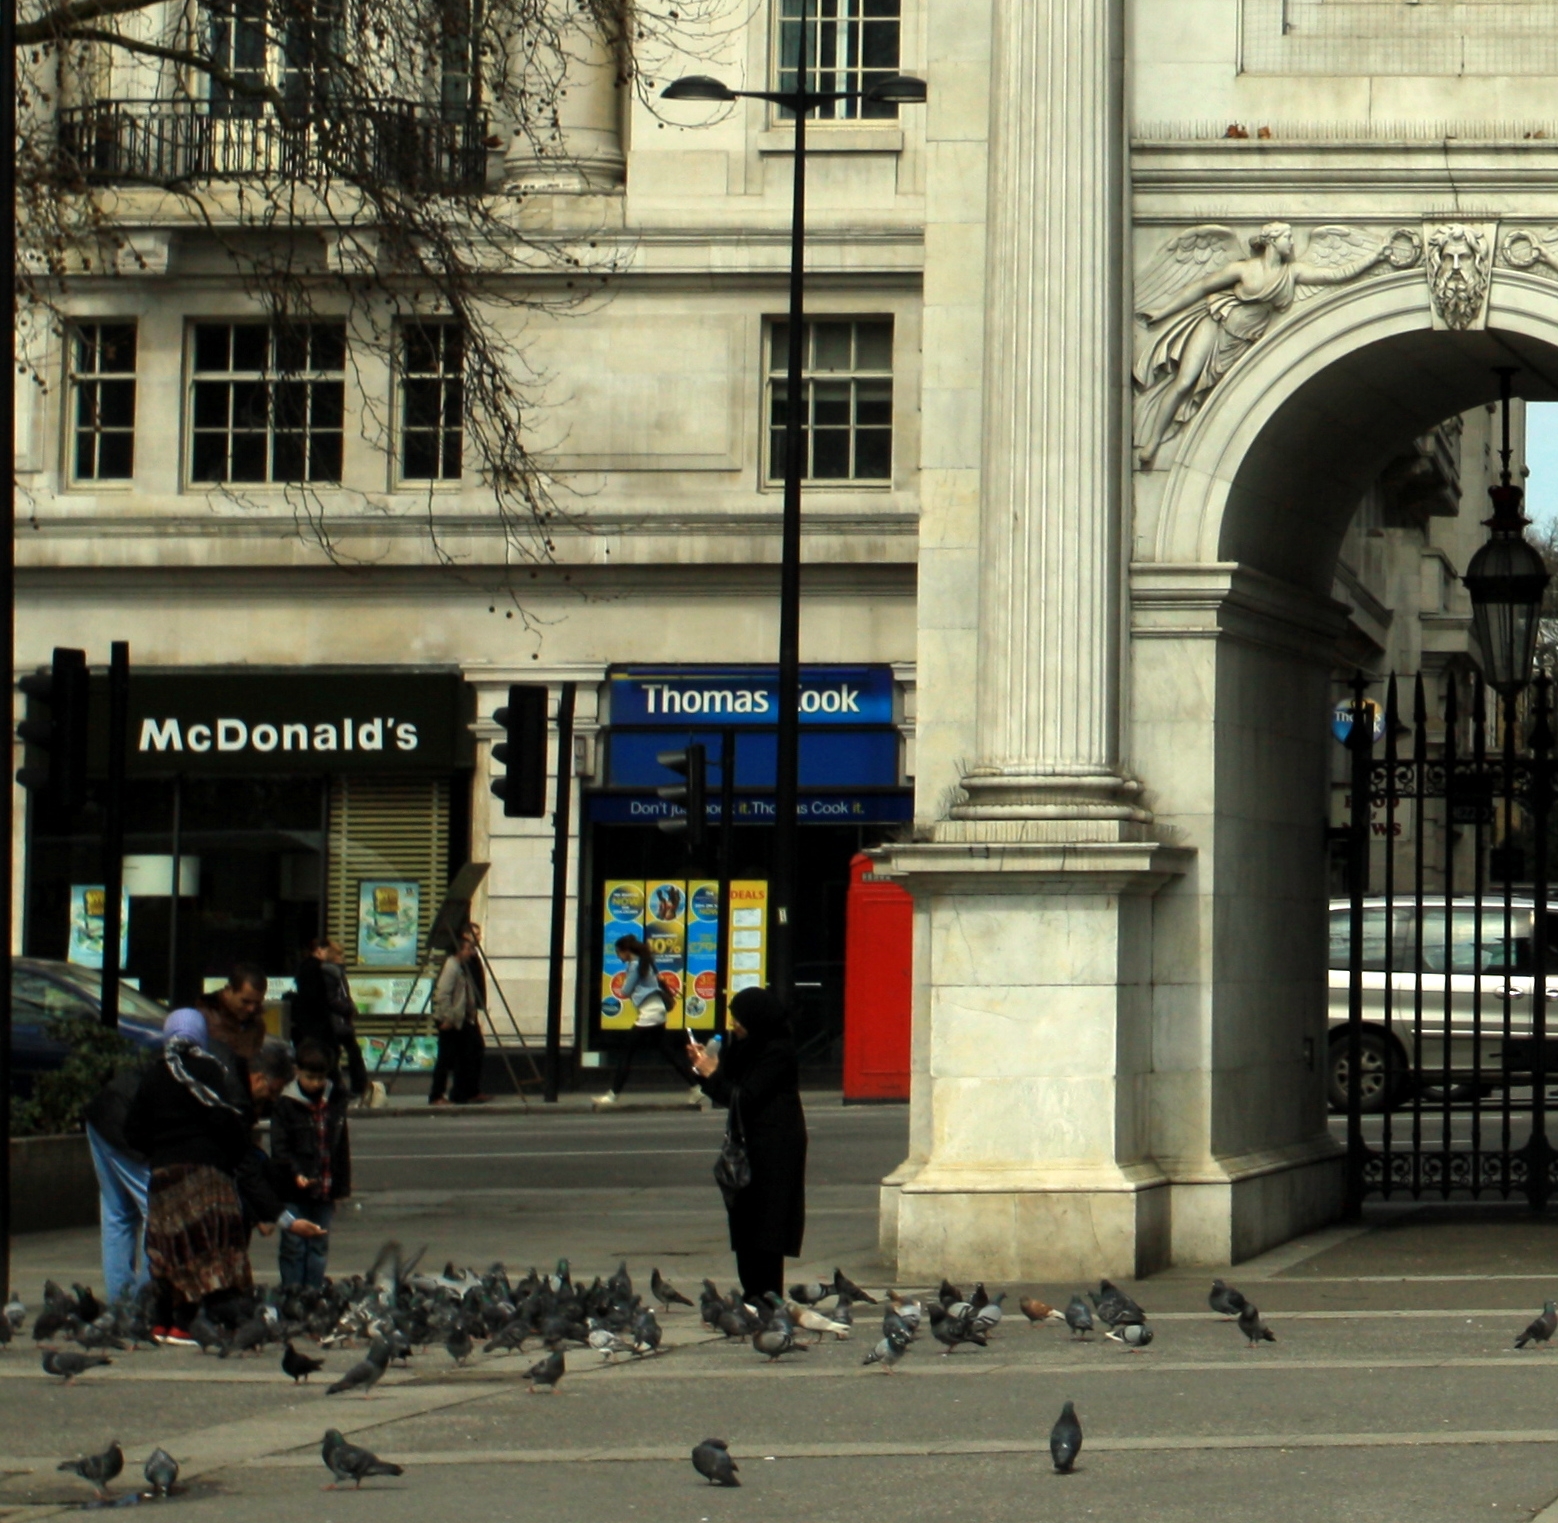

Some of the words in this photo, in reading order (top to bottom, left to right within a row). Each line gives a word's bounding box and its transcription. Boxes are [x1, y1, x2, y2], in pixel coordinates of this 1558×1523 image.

[641, 684, 770, 714] Thomas
[797, 684, 860, 713] ook
[1334, 710, 1381, 723] Thos
[138, 717, 419, 752] McDonald's
[630, 801, 668, 814] Don't
[670, 803, 687, 817] jus
[752, 801, 808, 815] Thos
[811, 801, 848, 815] Cook
[852, 802, 865, 814] it.
[730, 889, 765, 901] DEALS
[647, 937, 681, 954] 10%
